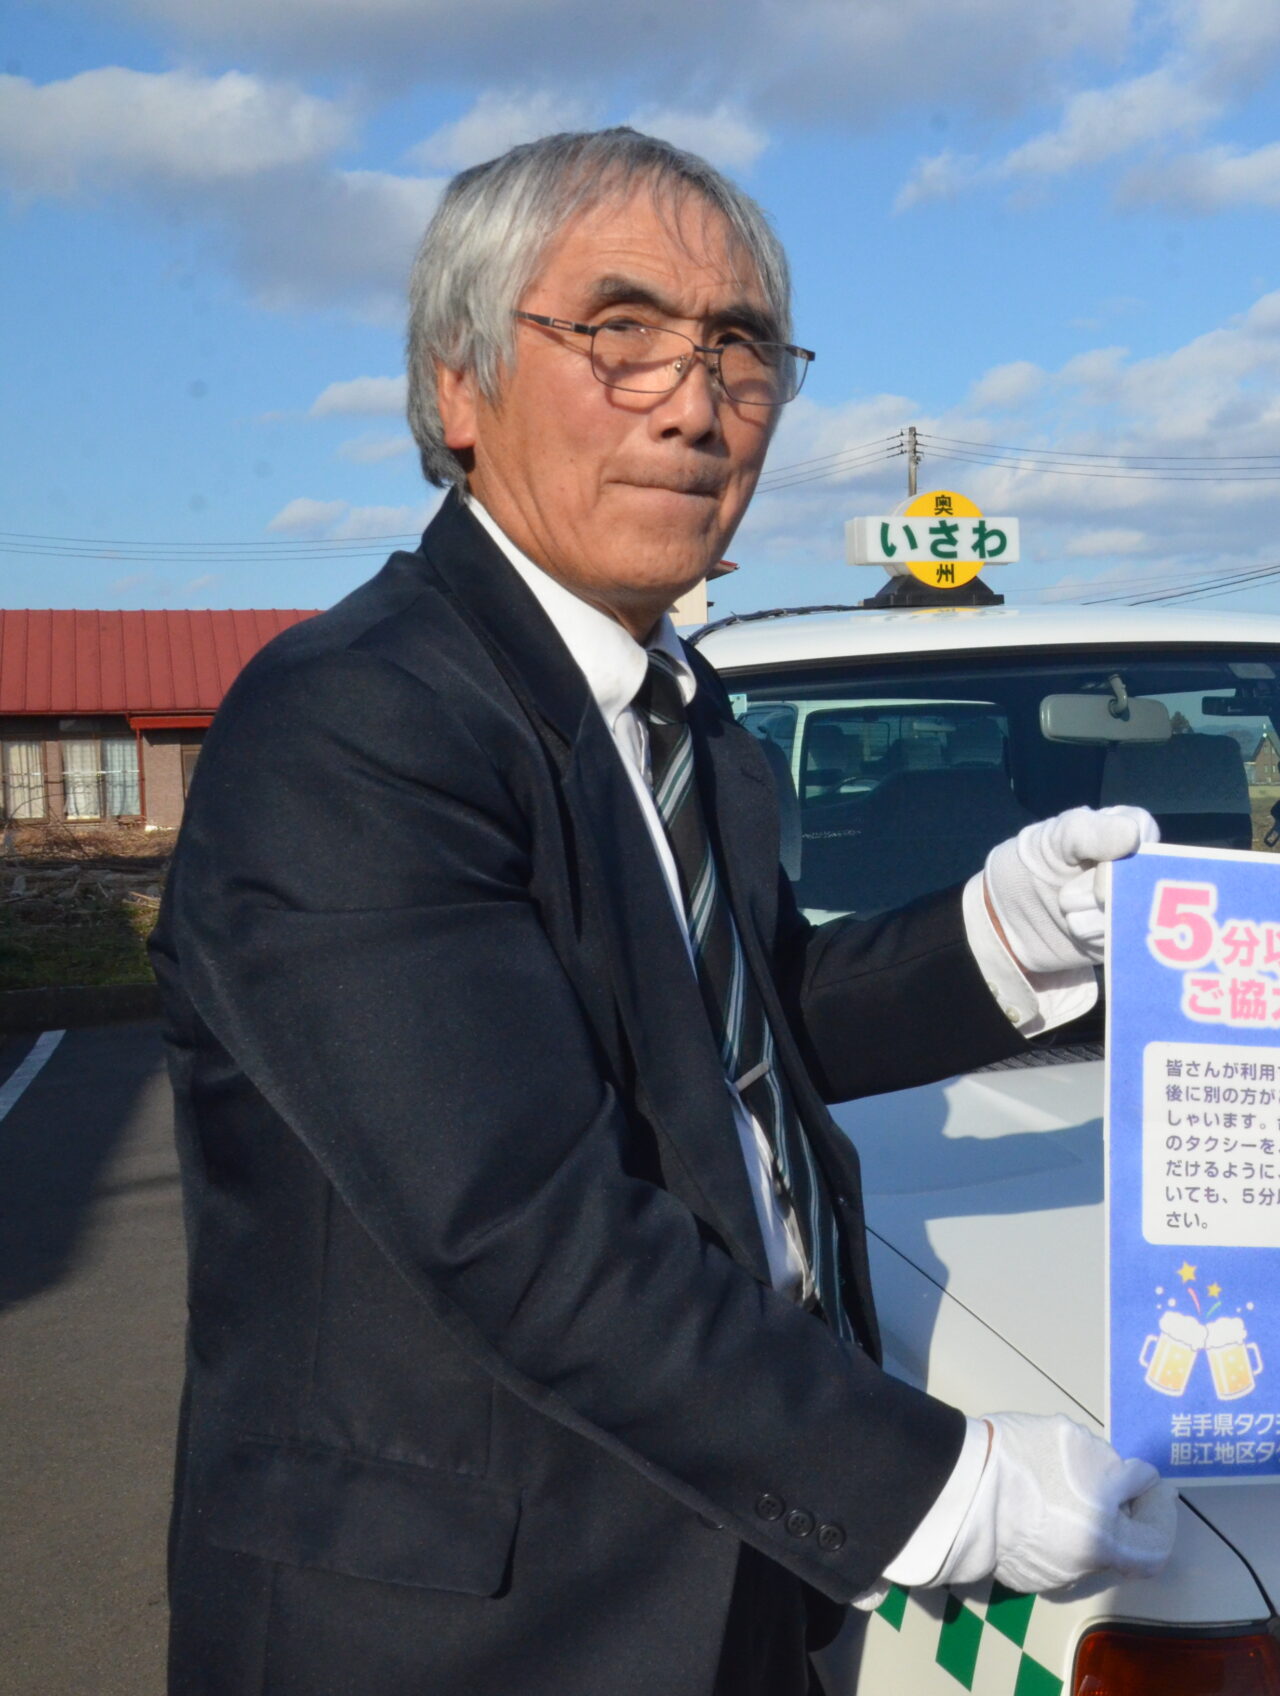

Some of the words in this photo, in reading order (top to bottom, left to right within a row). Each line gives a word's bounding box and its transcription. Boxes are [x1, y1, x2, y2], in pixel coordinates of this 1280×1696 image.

[935, 494, 954, 515] 奥
[880, 520, 1008, 560] いさわ
[936, 563, 955, 584] 州
[1165, 1211, 1210, 1231] さい。
